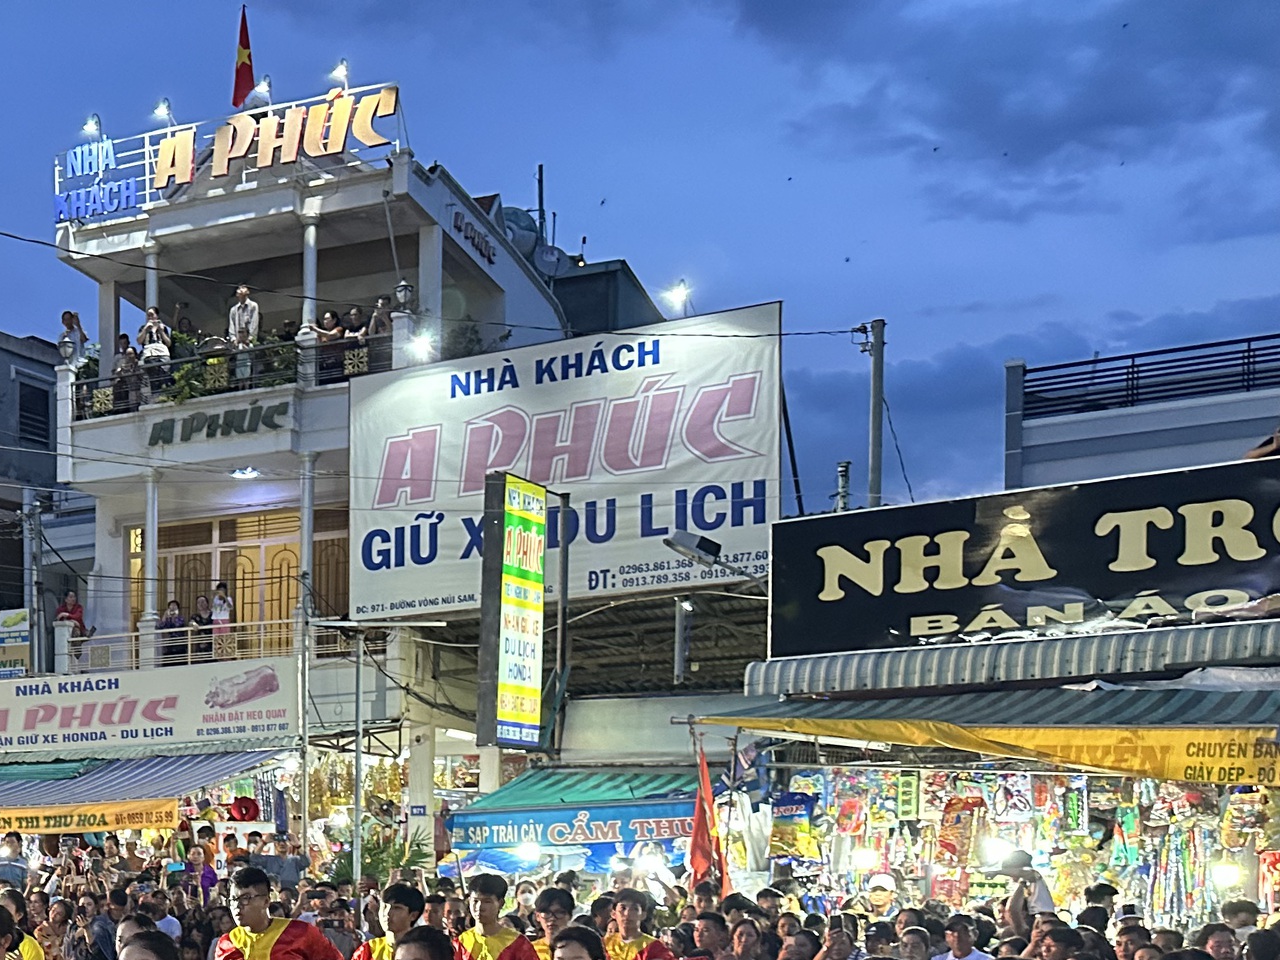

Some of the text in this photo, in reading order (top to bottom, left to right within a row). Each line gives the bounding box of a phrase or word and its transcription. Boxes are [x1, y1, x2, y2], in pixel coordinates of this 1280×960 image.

[66, 134, 117, 178] NHÀ
[154, 86, 400, 189] A PHÚC
[55, 177, 138, 221] KHÁCH
[450, 339, 661, 399] NHÀ KHÁCH
[149, 399, 290, 447] A PHÚC
[372, 370, 767, 510] A PHÚC
[361, 511, 444, 570] GIỮ
[546, 499, 616, 550] DU
[503, 525, 546, 575] A PHÚC
[1094, 499, 1280, 573] TR
[588, 569, 617, 591] ĐT:
[619, 559, 695, 576] 02963.861.368
[622, 572, 691, 588] 0913.789.358
[418, 597, 439, 608] VÒNG
[441, 594, 456, 605] NÚI
[910, 589, 1251, 638] BÁN ÁO
[505, 637, 536, 661] DU LỊCH
[15, 678, 120, 697] NHÀ KHÁCH
[508, 661, 532, 682] HONDA
[22, 694, 181, 732] PHÚC
[202, 708, 287, 725] NHẬN ĐẶT HEO QUAY
[16, 733, 40, 746] GIỮ
[42, 733, 59, 743] XE
[62, 731, 107, 743] HONDA
[120, 728, 139, 739] DU
[143, 726, 174, 740] LỊCH
[1185, 738, 1248, 758] CHUYÊN
[1183, 761, 1214, 780] GIÀY
[1217, 762, 1245, 782] DÉP
[43, 813, 73, 828] THU
[75, 812, 108, 827] HOA
[164, 811, 173, 822] 99
[468, 826, 490, 848] SẠP
[492, 820, 518, 843] TRÁI
[520, 818, 543, 843] CÂY
[547, 811, 622, 845] CẨM
